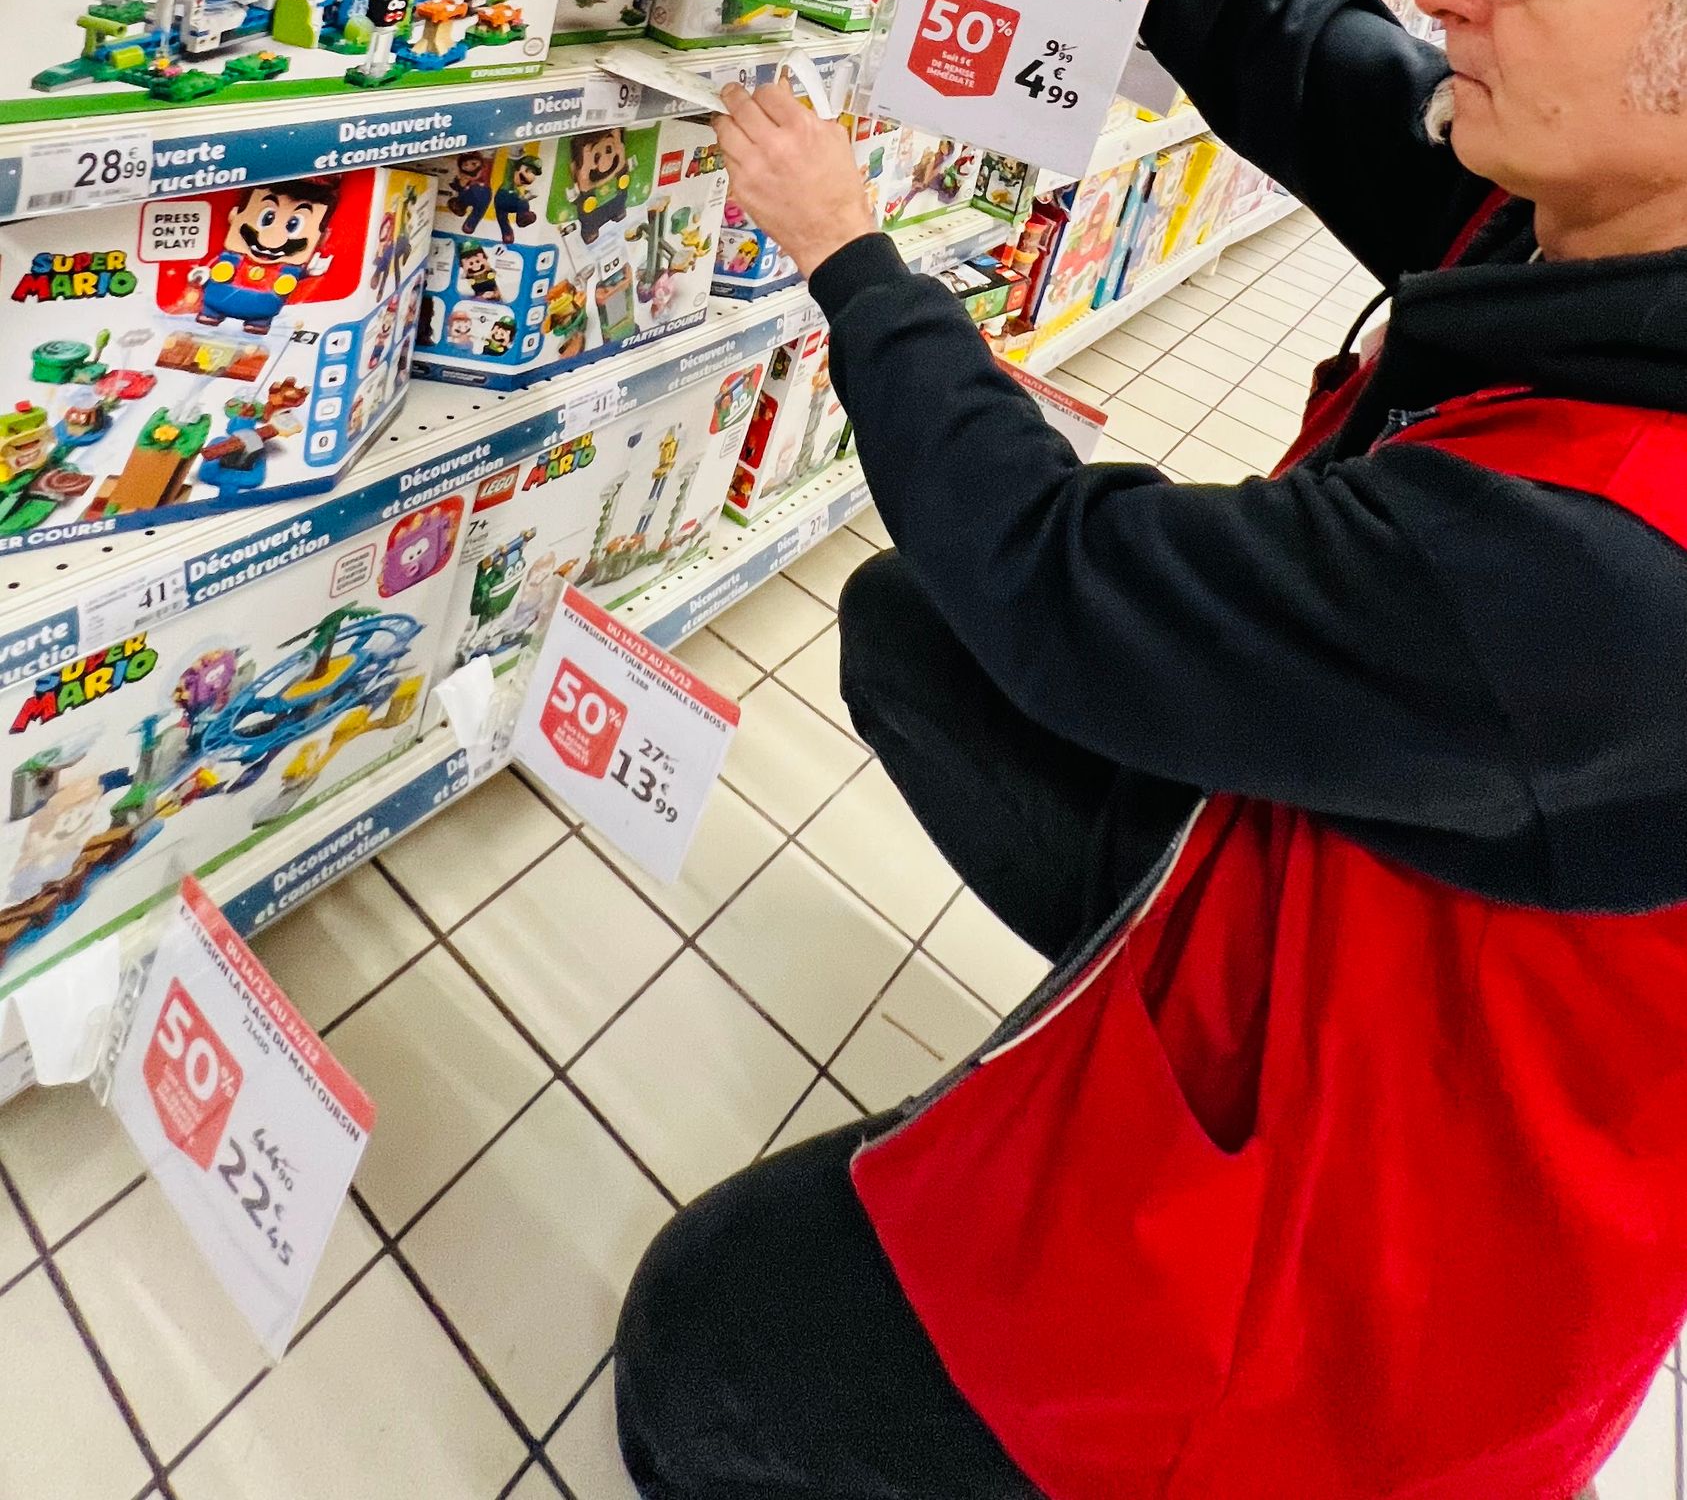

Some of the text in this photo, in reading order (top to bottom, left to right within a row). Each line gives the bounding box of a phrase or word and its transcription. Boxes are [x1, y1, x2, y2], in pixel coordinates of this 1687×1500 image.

[925, 66, 976, 88] IMMÉDIATE
[931, 58, 976, 79] DE REMISE
[941, 50, 961, 63] Soit
[339, 111, 453, 143] Découverte
[514, 119, 533, 139] et
[314, 133, 468, 171] et construction
[152, 225, 200, 238] ON TO
[154, 211, 200, 224] PRESS
[30, 249, 128, 276] SUPER
[154, 237, 196, 250] PLAY!
[11, 267, 140, 304] MARIO
[621, 323, 666, 349] STARTER
[679, 339, 736, 372] Découverte
[668, 350, 743, 390] et construction
[382, 454, 505, 521] et construction
[400, 441, 492, 493] Découverte
[482, 474, 516, 496] LEGO
[522, 447, 597, 492] MARIO
[26, 517, 117, 546] COURSE
[468, 518, 488, 536] 7+
[187, 516, 313, 583] Découverte
[194, 532, 330, 602] construction
[689, 572, 741, 614] Découverte
[692, 581, 748, 629] construction
[35, 631, 147, 691] SUPER
[606, 621, 664, 670] DU AU
[9, 647, 160, 734] MARIO
[563, 608, 729, 733] EXTENSION LA TOUR INFERNALE DU BOSS
[551, 670, 624, 736] 50%
[433, 787, 450, 805] et
[273, 816, 375, 893] Découverte
[254, 826, 391, 926] et construction
[225, 938, 321, 1066] DU 14/12 AU 24/12
[179, 903, 362, 1143] EXTENSION LA PLAGE DU MAXI OURSIN
[241, 1013, 271, 1057] 71400
[156, 998, 237, 1102] 50%
